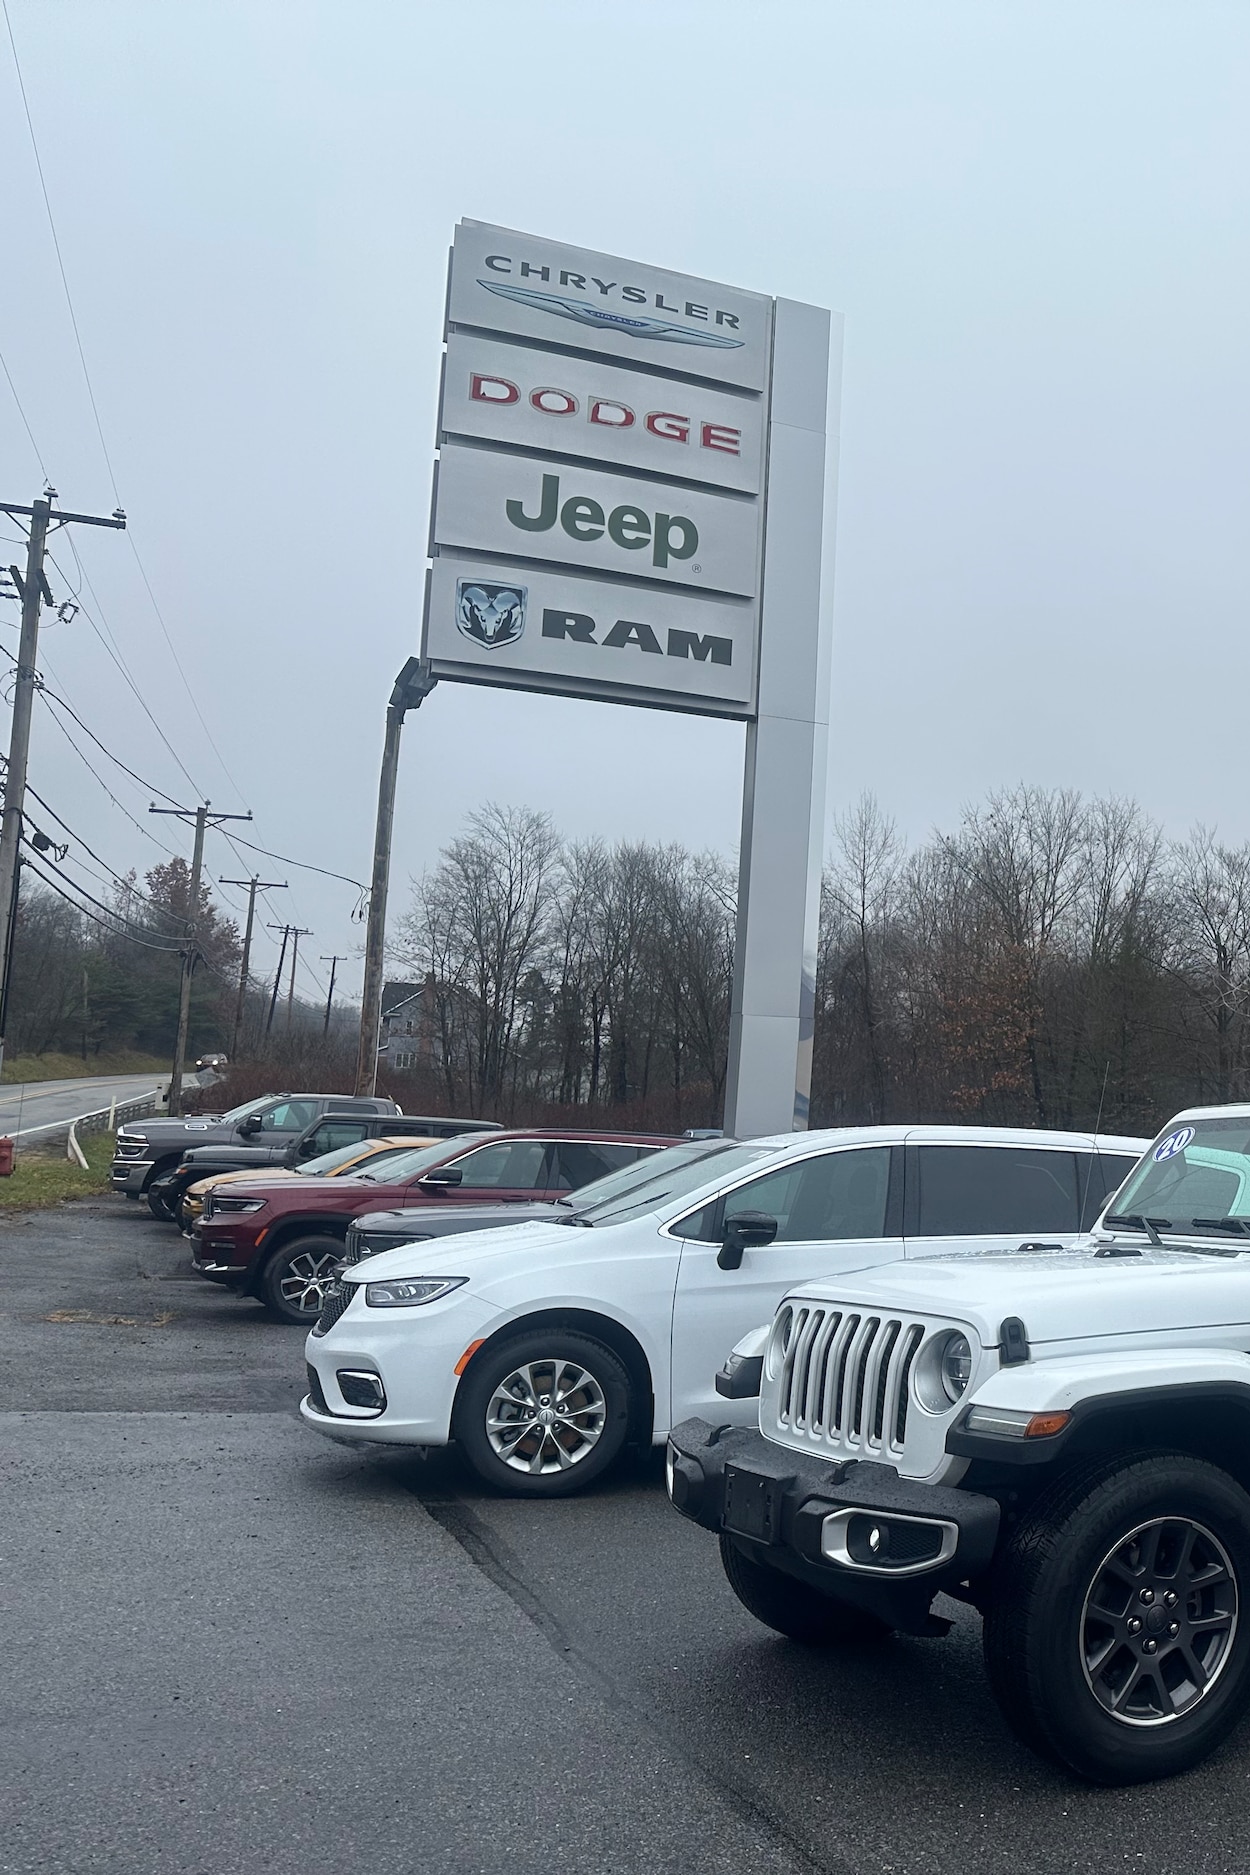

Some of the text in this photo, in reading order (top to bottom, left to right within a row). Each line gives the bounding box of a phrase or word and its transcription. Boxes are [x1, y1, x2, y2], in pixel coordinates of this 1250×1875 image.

[484, 255, 740, 330] CHRYSLER
[468, 371, 742, 457] DODGE
[505, 473, 699, 569] Jeep
[541, 608, 733, 667] RAM
[1157, 1129, 1190, 1160] 20
